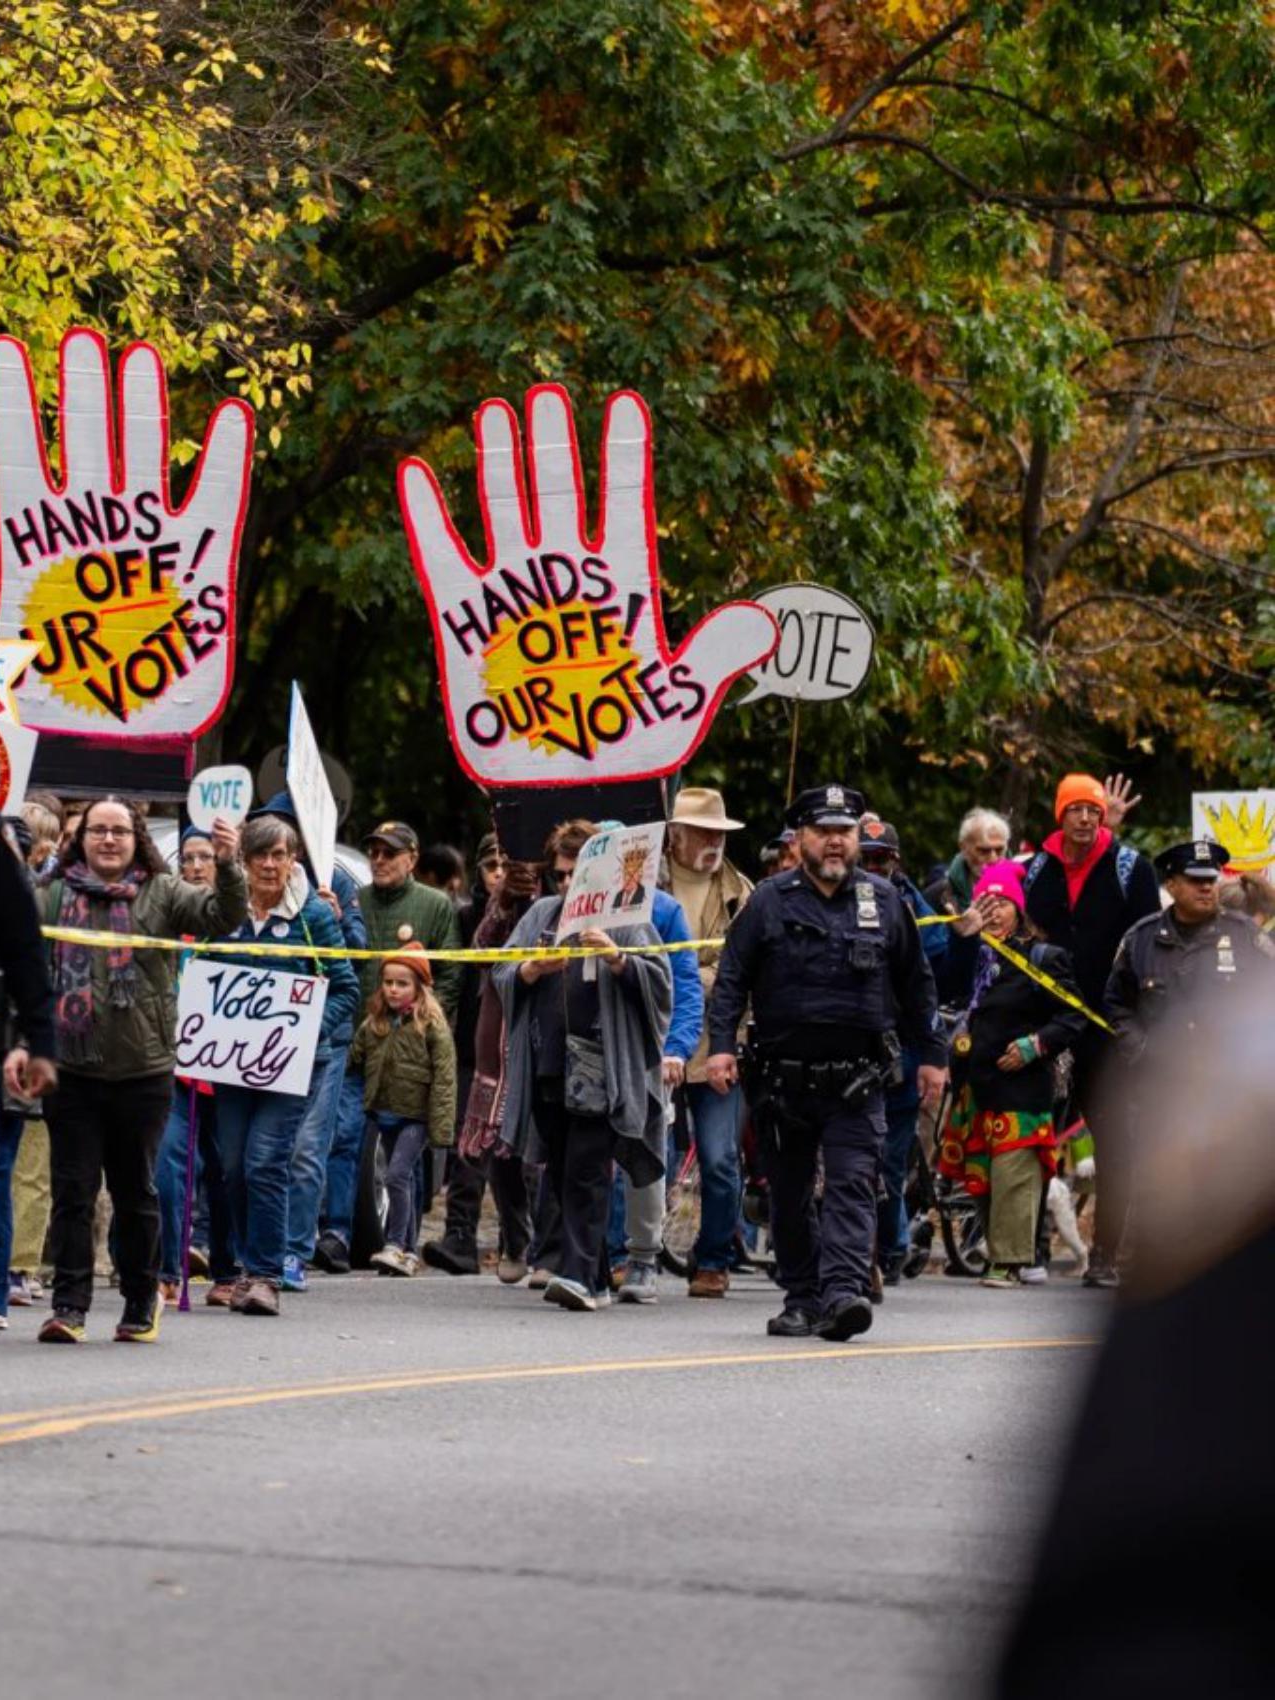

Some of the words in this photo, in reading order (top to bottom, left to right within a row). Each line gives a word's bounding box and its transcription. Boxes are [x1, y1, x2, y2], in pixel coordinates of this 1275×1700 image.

[4, 490, 161, 567] HANDS
[75, 527, 215, 603] OFF!
[442, 553, 617, 656] HANDS
[517, 593, 646, 663] OFF!
[10, 610, 113, 689] UR
[84, 585, 227, 723] VOTES
[466, 677, 570, 747] OUR
[541, 658, 705, 760] VOTES
[199, 779, 243, 811] VOTE
[208, 970, 300, 1026] Vote
[176, 1013, 299, 1087] Early
